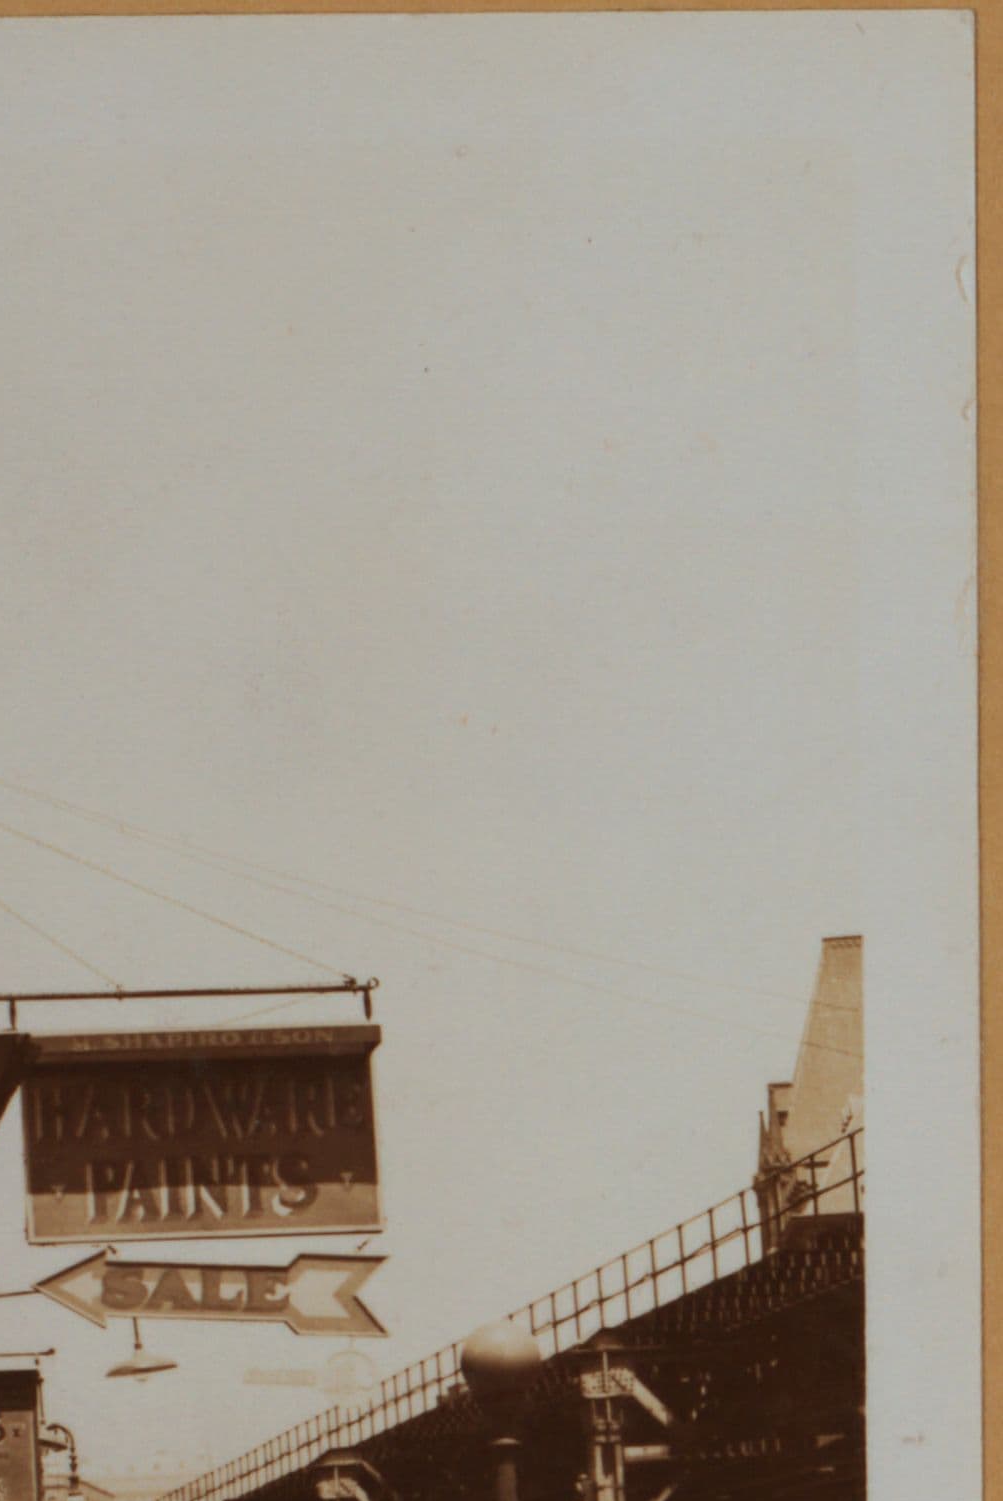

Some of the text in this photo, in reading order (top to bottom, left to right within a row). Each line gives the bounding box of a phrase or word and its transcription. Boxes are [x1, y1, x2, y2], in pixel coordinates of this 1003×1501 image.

[33, 1074, 368, 1142] HARDWARE
[86, 1153, 319, 1226] PAINTS
[100, 1266, 290, 1313] SALE
